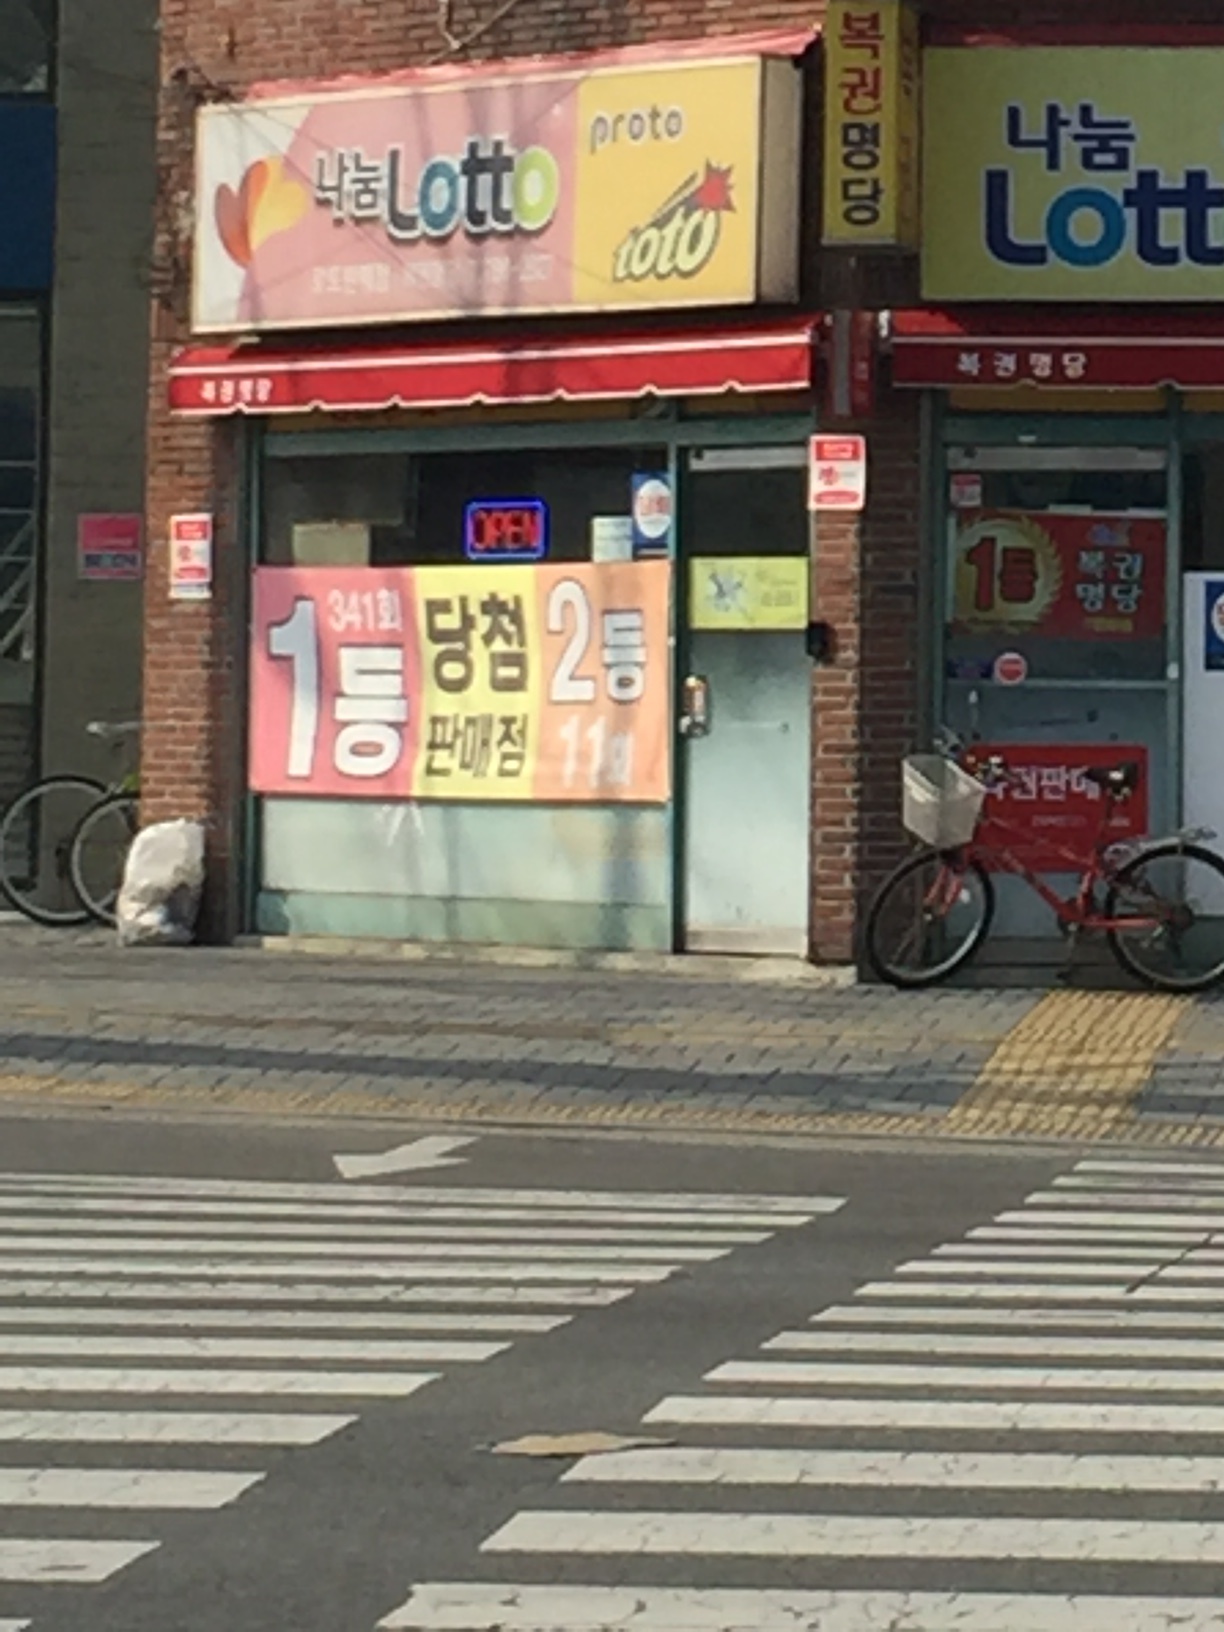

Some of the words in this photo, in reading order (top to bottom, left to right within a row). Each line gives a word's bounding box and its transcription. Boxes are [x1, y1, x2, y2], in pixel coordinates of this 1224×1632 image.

[588, 103, 683, 153] proto
[1006, 102, 1137, 172] 나눔
[314, 149, 384, 226] 나눔
[386, 136, 560, 243] Lotto
[611, 206, 721, 282] toto
[327, 587, 404, 632] 341회
[425, 591, 529, 695] 당첨
[546, 576, 648, 704] 2등
[267, 595, 409, 780] 1등
[425, 712, 529, 779] 판매점
